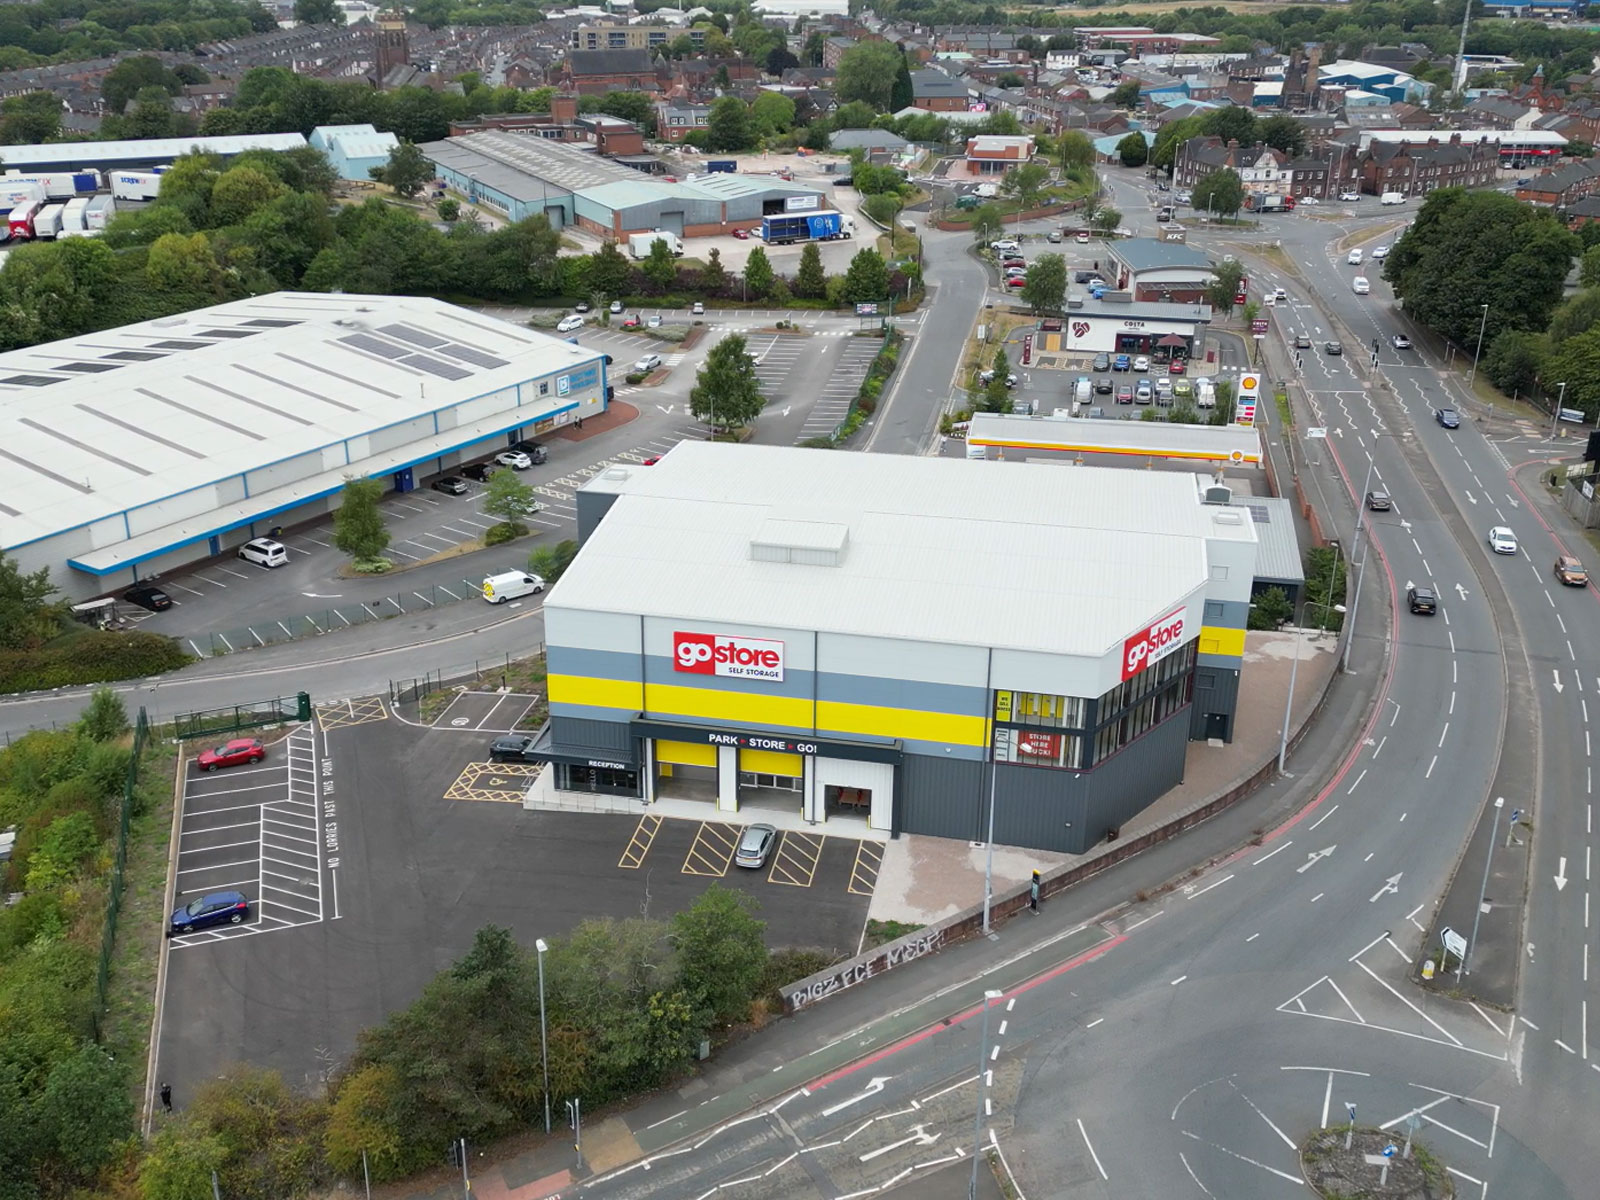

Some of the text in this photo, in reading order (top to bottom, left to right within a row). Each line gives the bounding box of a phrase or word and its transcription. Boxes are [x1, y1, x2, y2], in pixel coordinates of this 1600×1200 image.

[1127, 619, 1184, 672] go store
[677, 642, 780, 668] go store
[728, 667, 779, 678] SELF STORAGE
[708, 733, 817, 753] PARK STORE GO!
[1029, 733, 1051, 741] STORE
[1030, 741, 1049, 749] HERE
[588, 760, 625, 770] RECEPTION
[321, 758, 340, 868] NO LORRIES PAST THIS POINT
